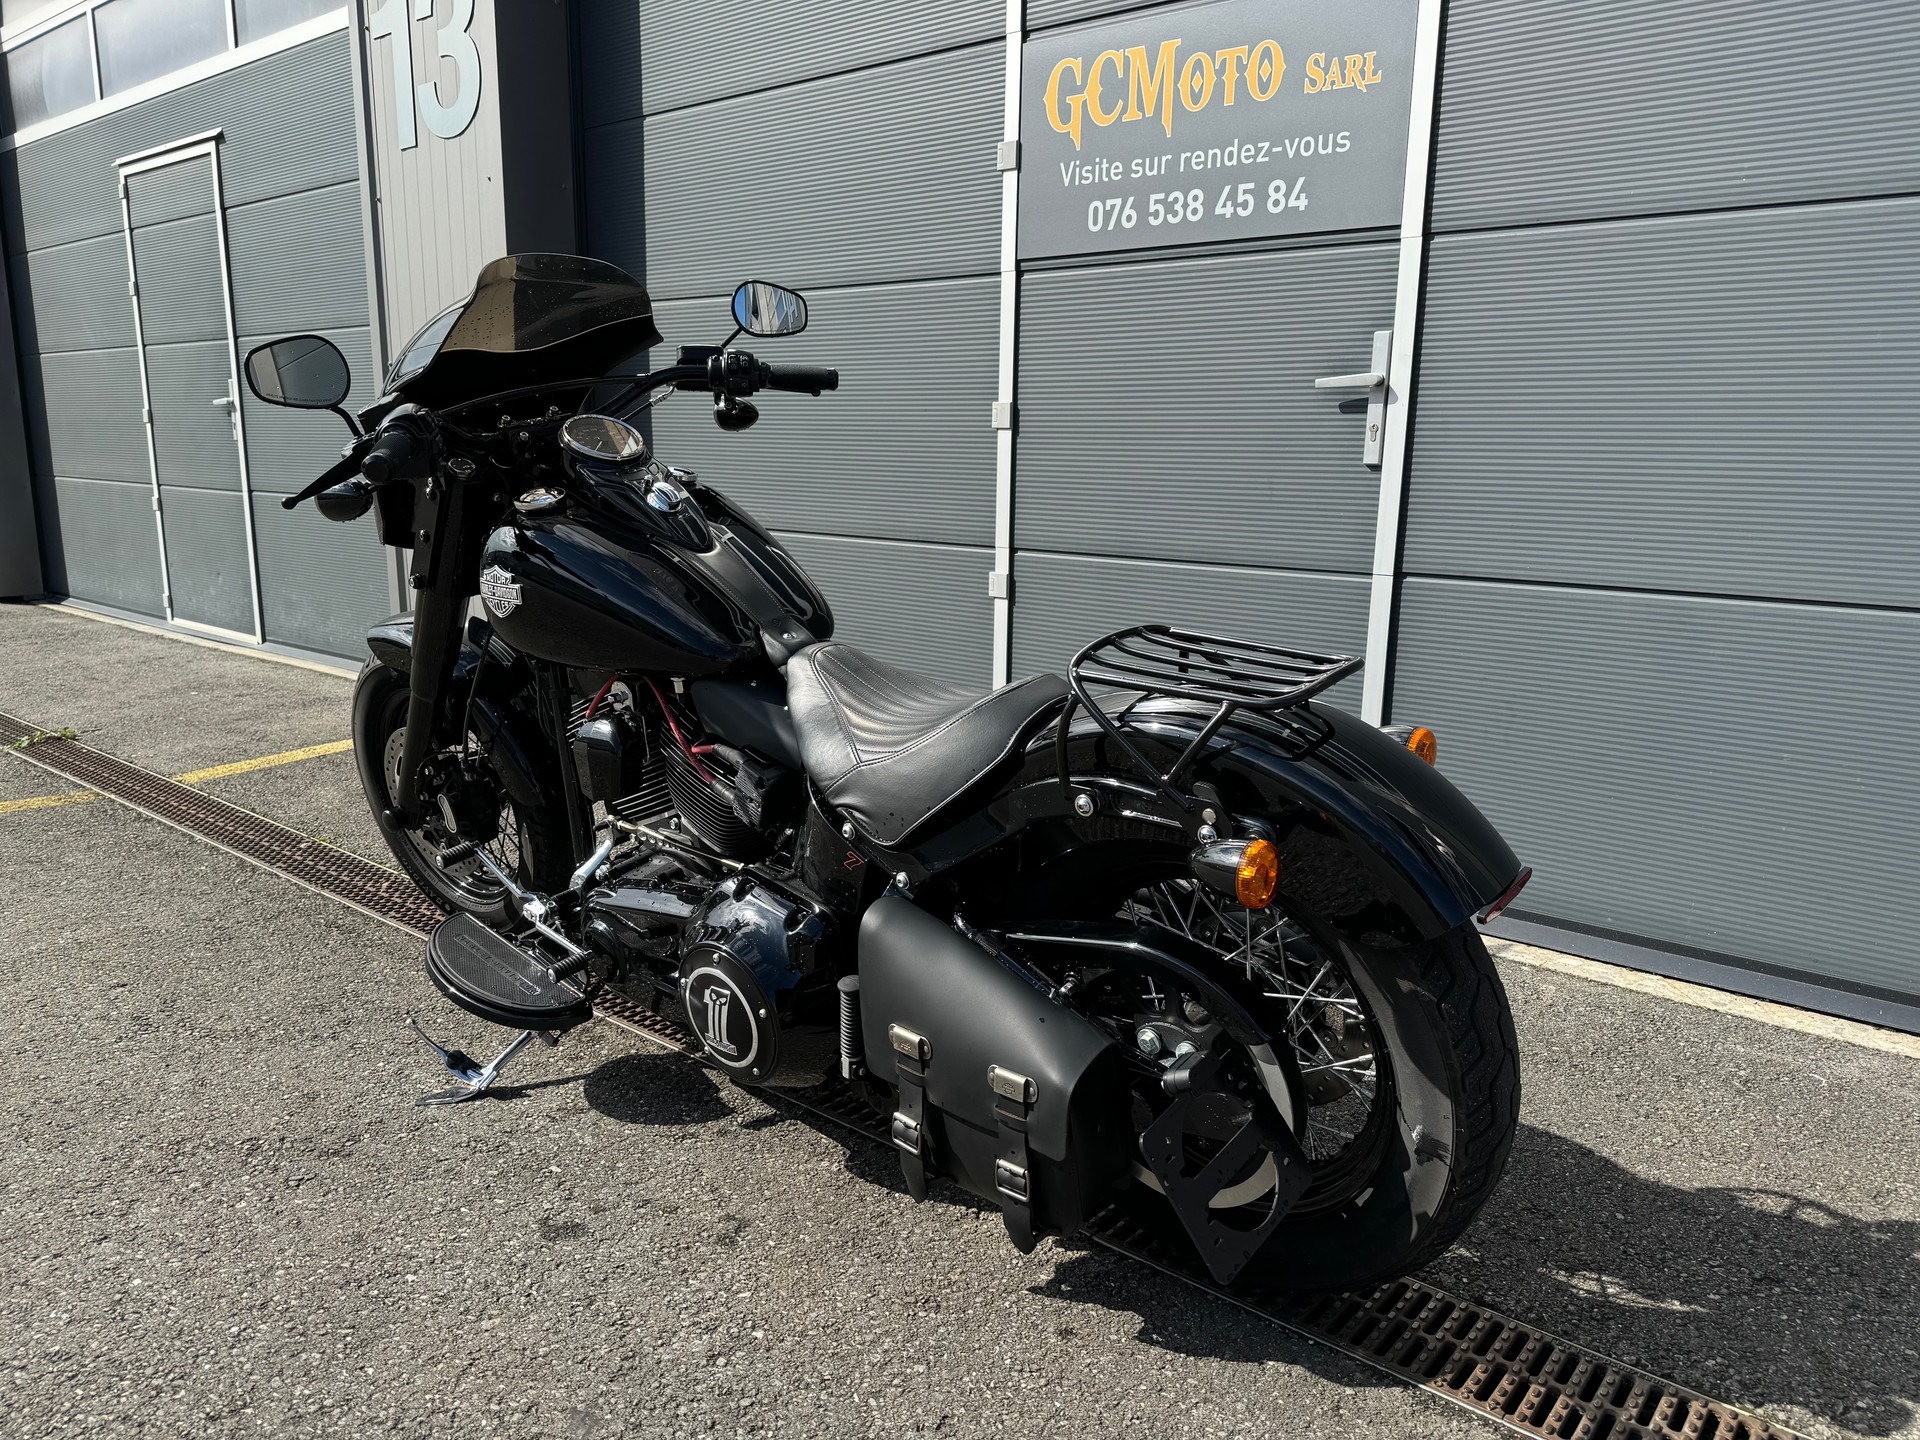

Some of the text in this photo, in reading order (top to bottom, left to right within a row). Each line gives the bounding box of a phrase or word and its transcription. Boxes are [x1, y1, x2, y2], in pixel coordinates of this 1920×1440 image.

[370, 0, 482, 151] 13
[1060, 130, 1351, 188] Visite sur rendez-vous
[1087, 176, 1309, 233] 076 538 45 84
